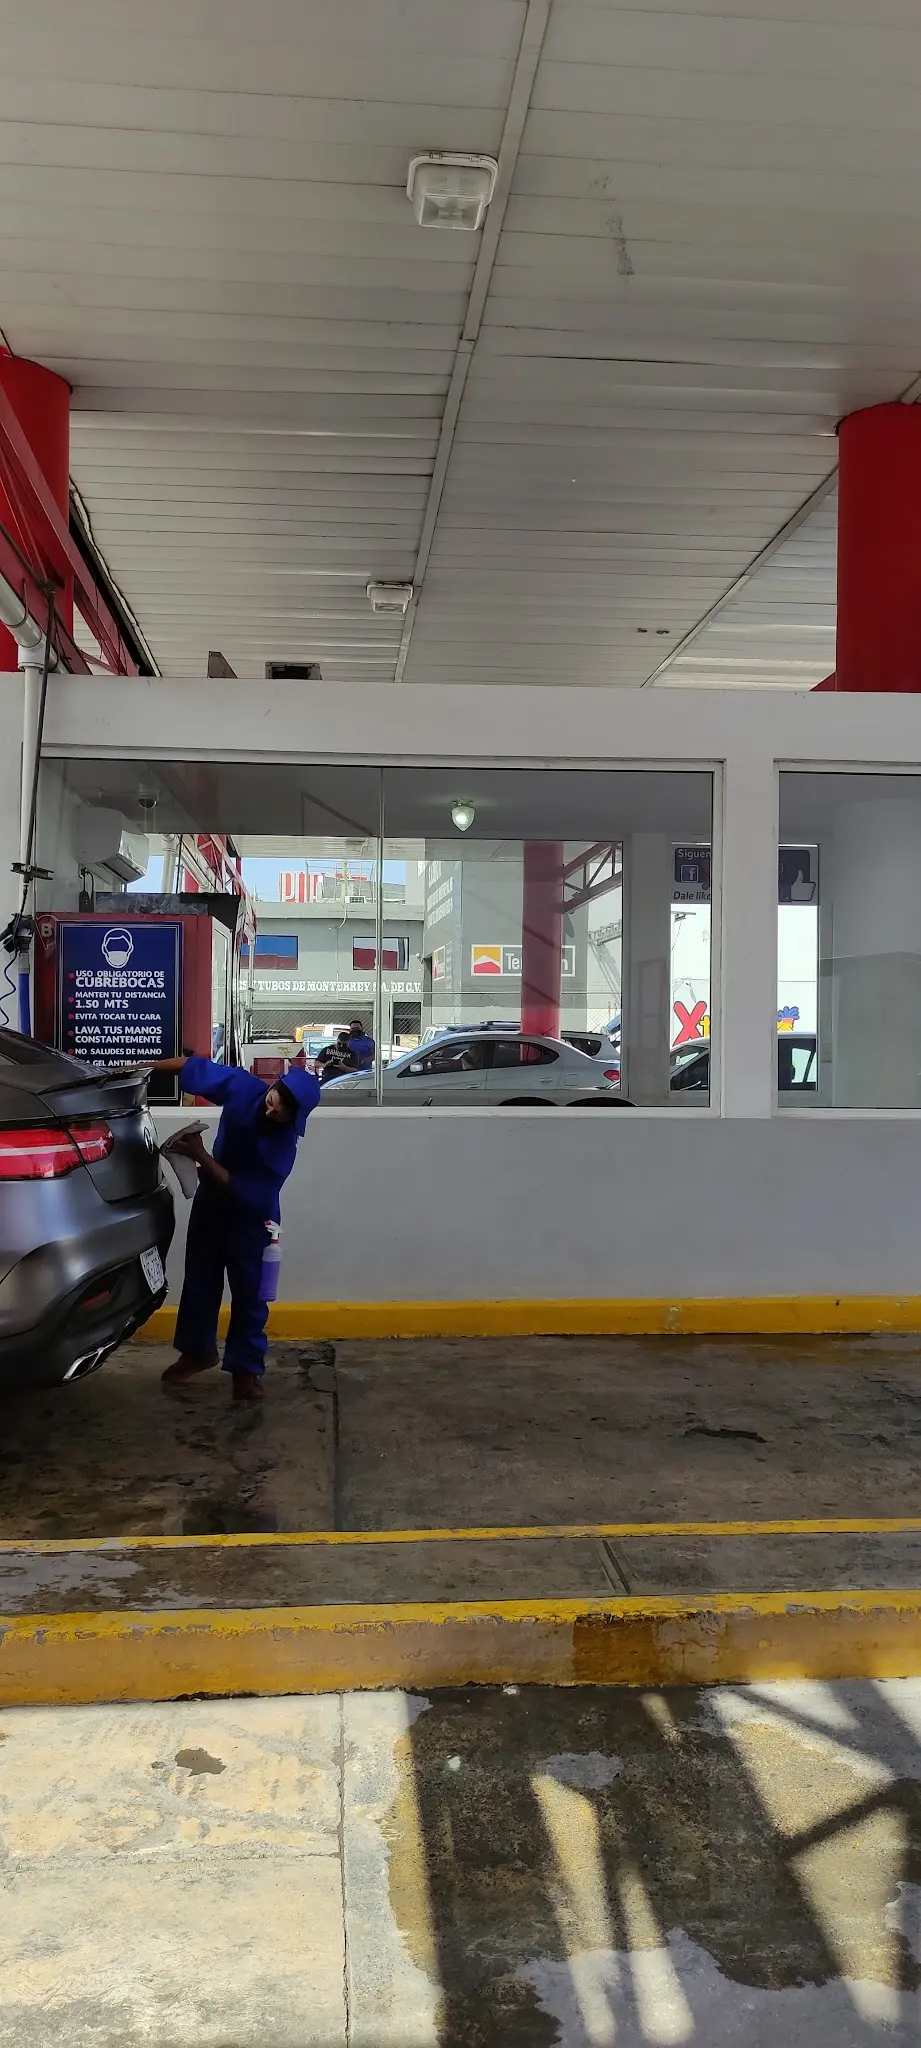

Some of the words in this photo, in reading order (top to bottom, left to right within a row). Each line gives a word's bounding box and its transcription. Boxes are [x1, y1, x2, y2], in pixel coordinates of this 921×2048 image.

[673, 891, 694, 900] Dale
[96, 970, 151, 978] OBLIGATORIO
[75, 977, 165, 988] CUBREBOCAS
[260, 981, 291, 991] TUBOS
[292, 982, 306, 991] DE
[309, 981, 370, 992] MONTERREY
[391, 981, 404, 991] DE
[405, 982, 422, 992] C.V.
[75, 1000, 99, 1009] 1.50
[104, 1000, 129, 1009] MTS
[75, 1026, 100, 1034] LAVA
[103, 1026, 123, 1034] TUS
[125, 1026, 162, 1034] MANOS
